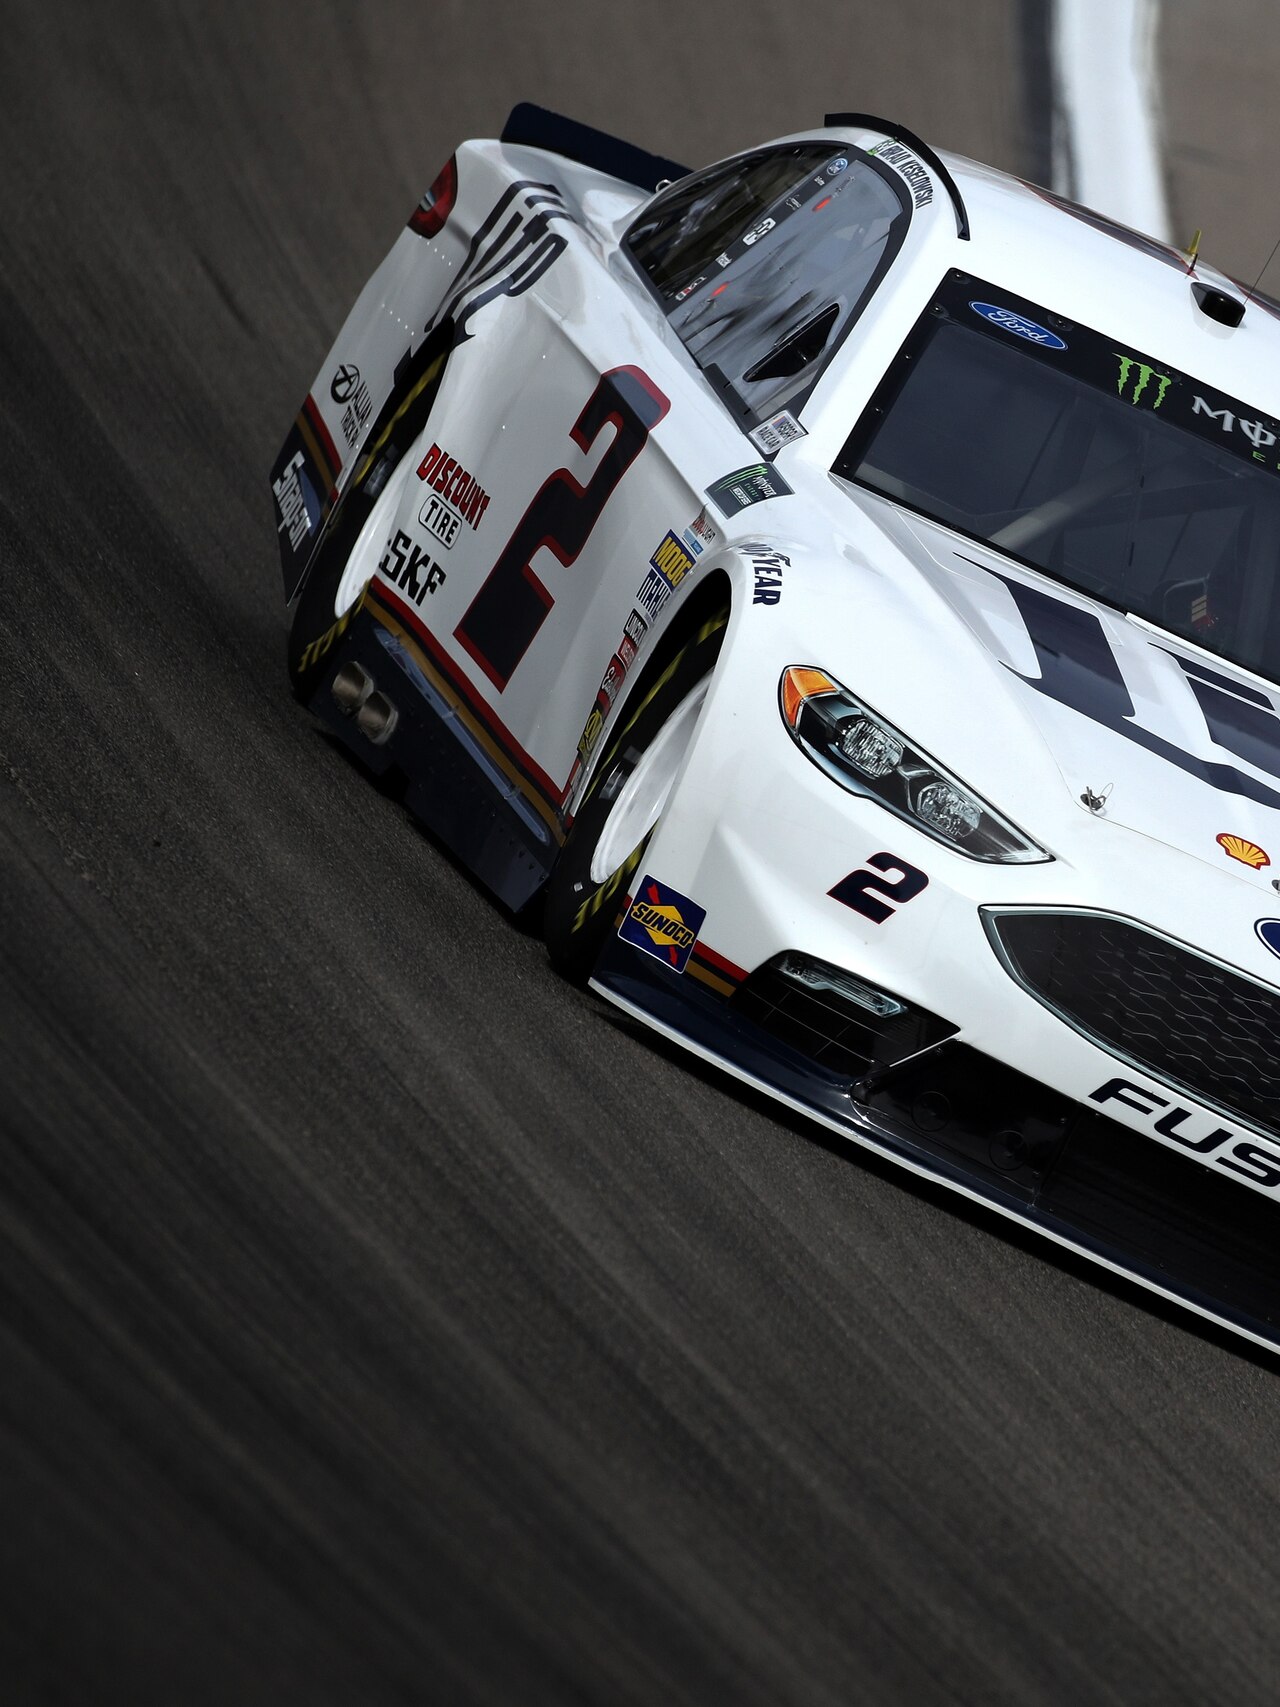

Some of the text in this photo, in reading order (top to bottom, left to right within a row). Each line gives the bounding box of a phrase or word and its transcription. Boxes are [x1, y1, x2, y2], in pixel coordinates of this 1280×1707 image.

[988, 310, 1046, 343] Ford
[416, 442, 491, 531] DISCOUNT
[424, 499, 459, 544] TIRE
[453, 364, 671, 694] 2
[380, 528, 447, 607] SKF
[652, 536, 693, 587] MOOG
[826, 851, 929, 925] 2
[633, 903, 692, 947] SUNOCO
